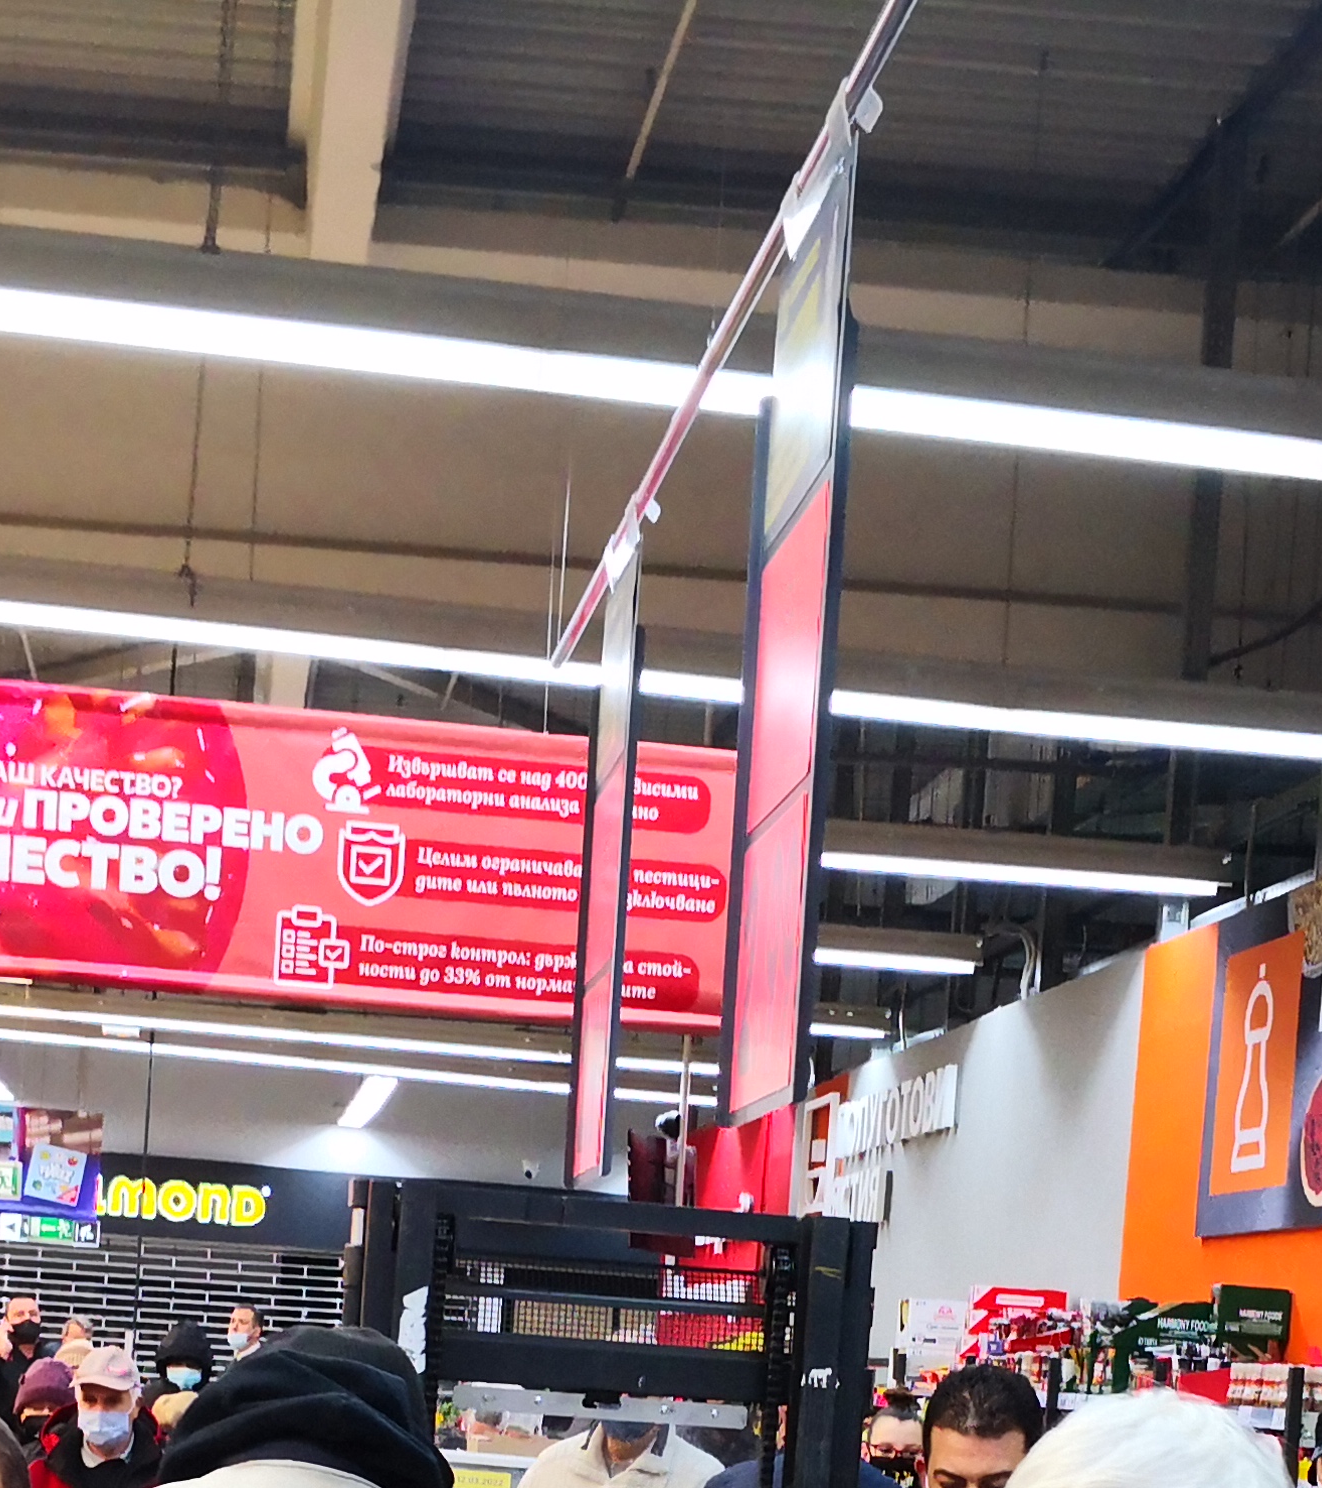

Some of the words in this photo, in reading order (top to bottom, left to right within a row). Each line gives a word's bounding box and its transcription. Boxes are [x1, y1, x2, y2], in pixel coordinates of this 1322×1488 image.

[39, 763, 183, 799] КАЧЕСТВО?
[387, 754, 495, 784] Извършват
[497, 768, 516, 783] се
[521, 769, 551, 792] над
[633, 777, 700, 801] висими
[385, 784, 506, 813] лабораторни
[509, 795, 581, 818] анализа
[22, 787, 324, 855] ПРОВЕРЕНО
[417, 846, 478, 872] Целим
[481, 855, 583, 882] ограничава
[415, 876, 462, 896] дите
[466, 881, 499, 896] или
[502, 880, 578, 903] пълното
[626, 889, 717, 914] зключване
[359, 934, 447, 962] По-строг
[451, 941, 531, 968] контрол:
[359, 962, 417, 981] ности
[419, 968, 441, 986] до
[443, 966, 481, 987] 33%
[485, 973, 511, 989] от
